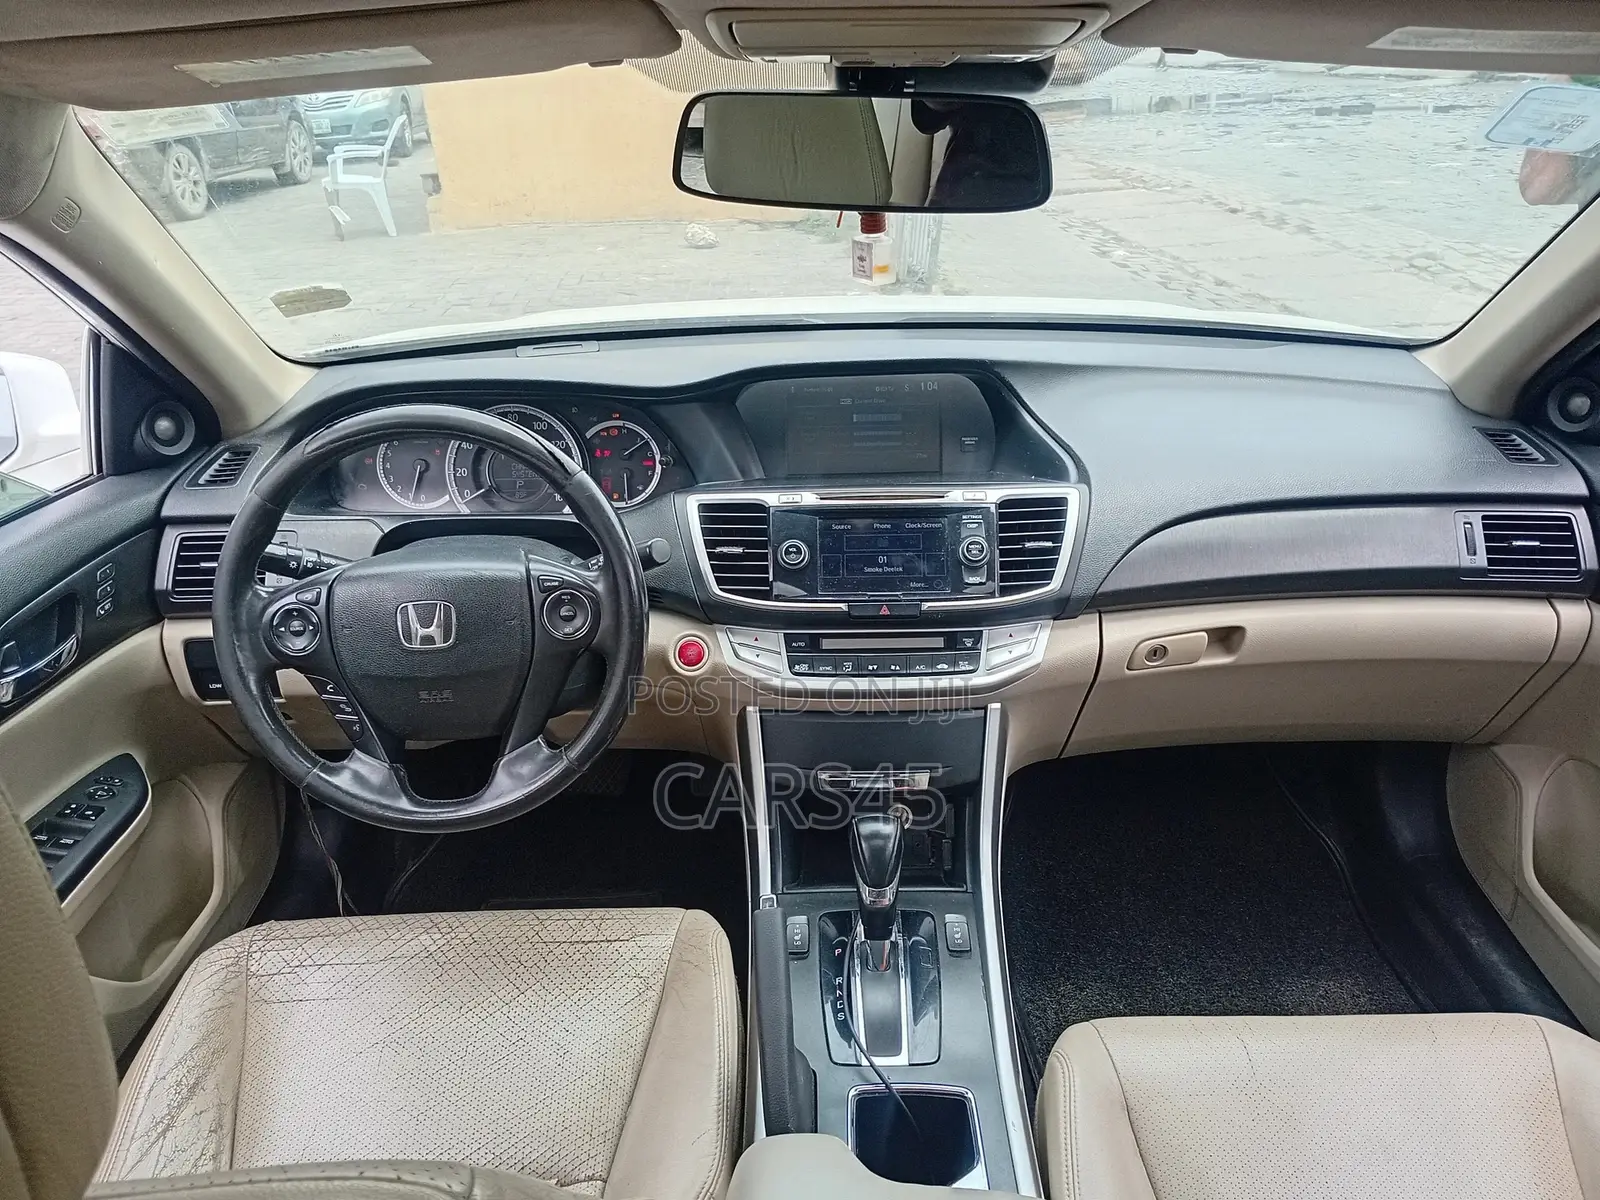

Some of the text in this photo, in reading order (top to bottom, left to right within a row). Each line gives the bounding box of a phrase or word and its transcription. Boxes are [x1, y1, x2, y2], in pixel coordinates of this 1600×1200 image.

[507, 413, 519, 422] 80
[532, 421, 548, 430] 100
[456, 468, 468, 477] 20
[516, 480, 524, 489] P
[464, 489, 471, 498] 0
[878, 556, 888, 564] 01
[835, 948, 842, 956] P
[836, 977, 843, 985] R
[837, 1012, 845, 1020] S
